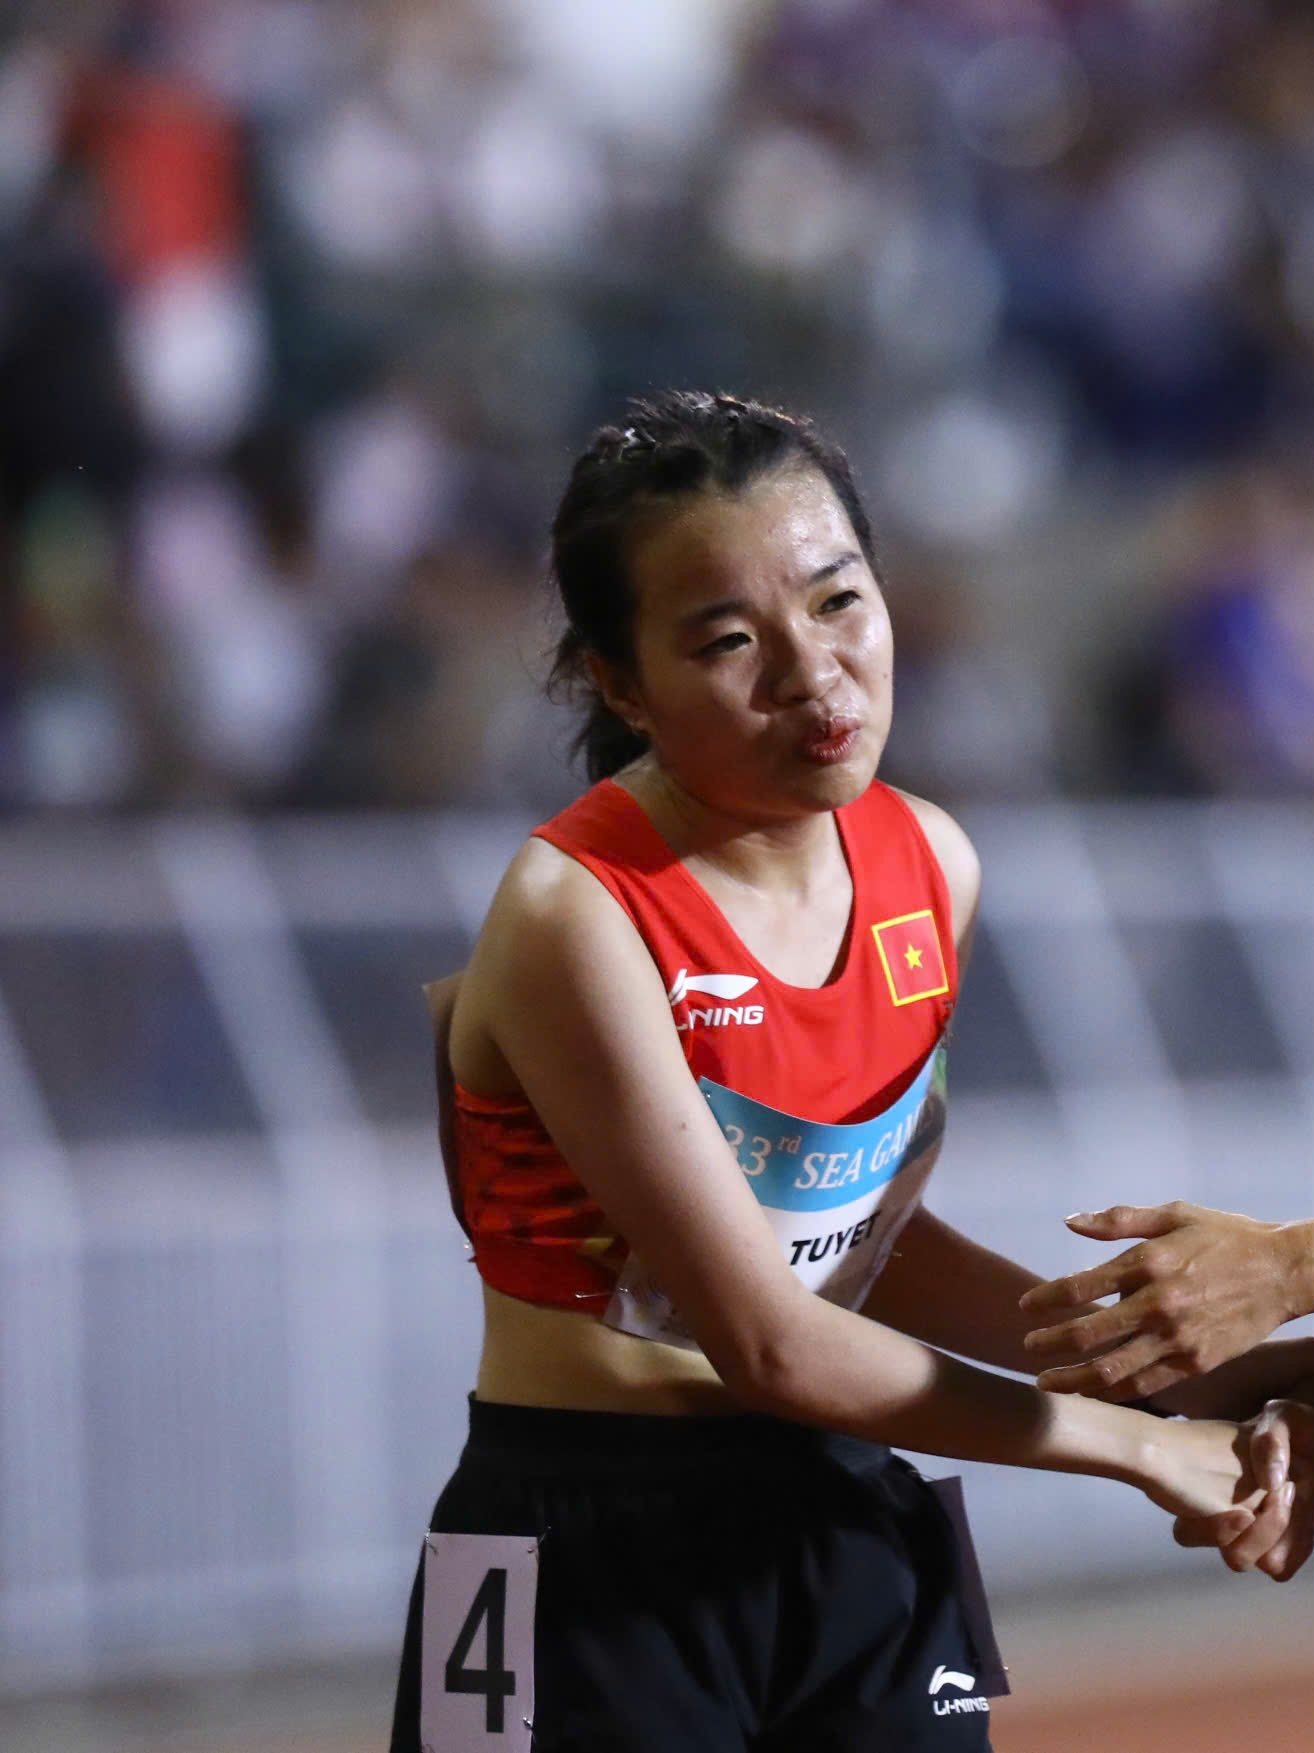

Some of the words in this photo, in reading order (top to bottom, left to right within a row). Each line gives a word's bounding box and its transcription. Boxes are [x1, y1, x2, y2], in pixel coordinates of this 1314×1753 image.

[794, 1147, 864, 1190] SEA
[789, 1212, 880, 1266] TUYET
[445, 1568, 516, 1733] 4
[933, 1696, 989, 1716] LI-NING
